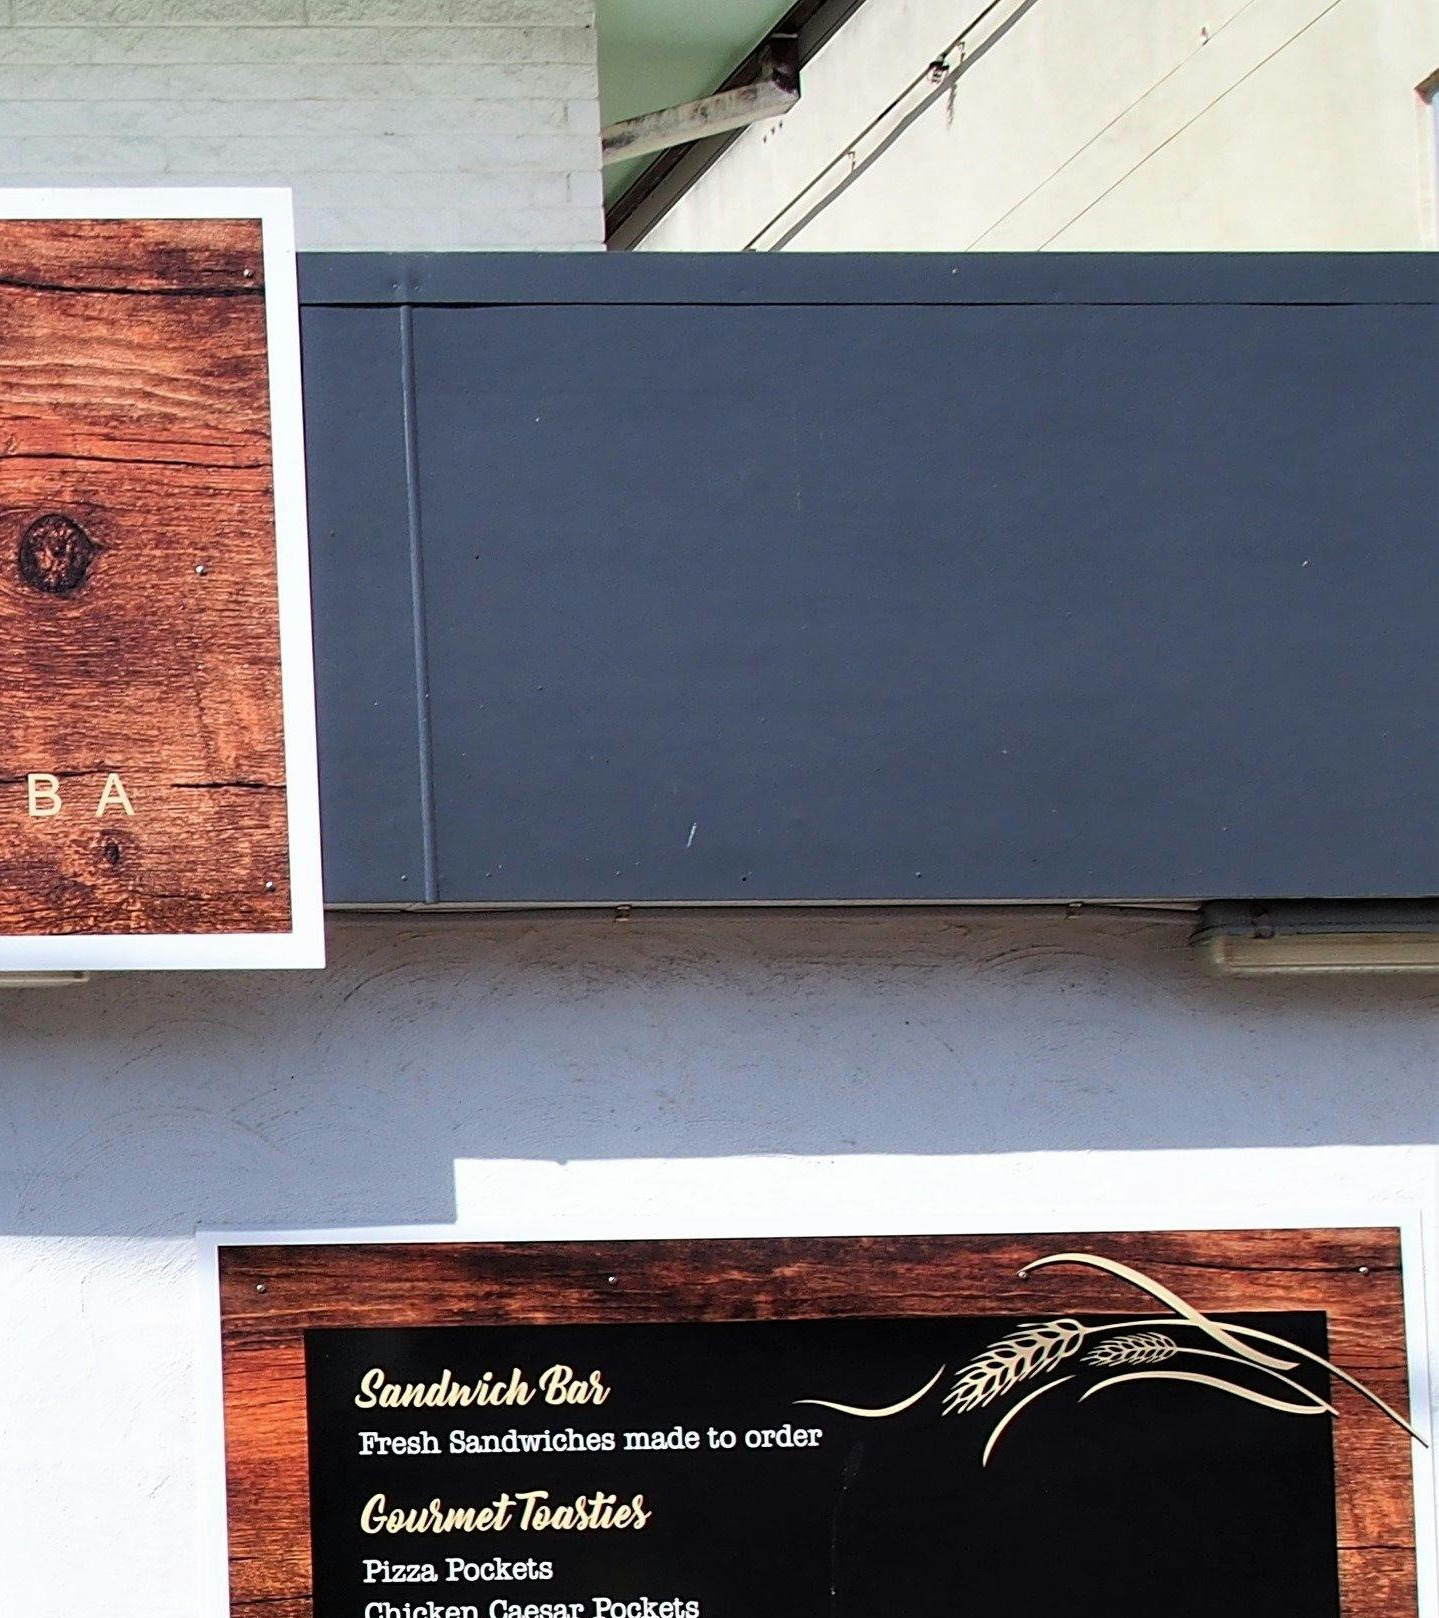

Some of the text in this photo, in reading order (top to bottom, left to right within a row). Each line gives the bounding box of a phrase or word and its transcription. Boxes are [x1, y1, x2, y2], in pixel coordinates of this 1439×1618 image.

[354, 1363, 611, 1409] Sandwich Bar
[358, 1423, 823, 1456] Fresh Sandwiches made to order
[360, 1490, 652, 1534] Gourmet Toasties
[362, 1557, 554, 1584] Pizza Pockets
